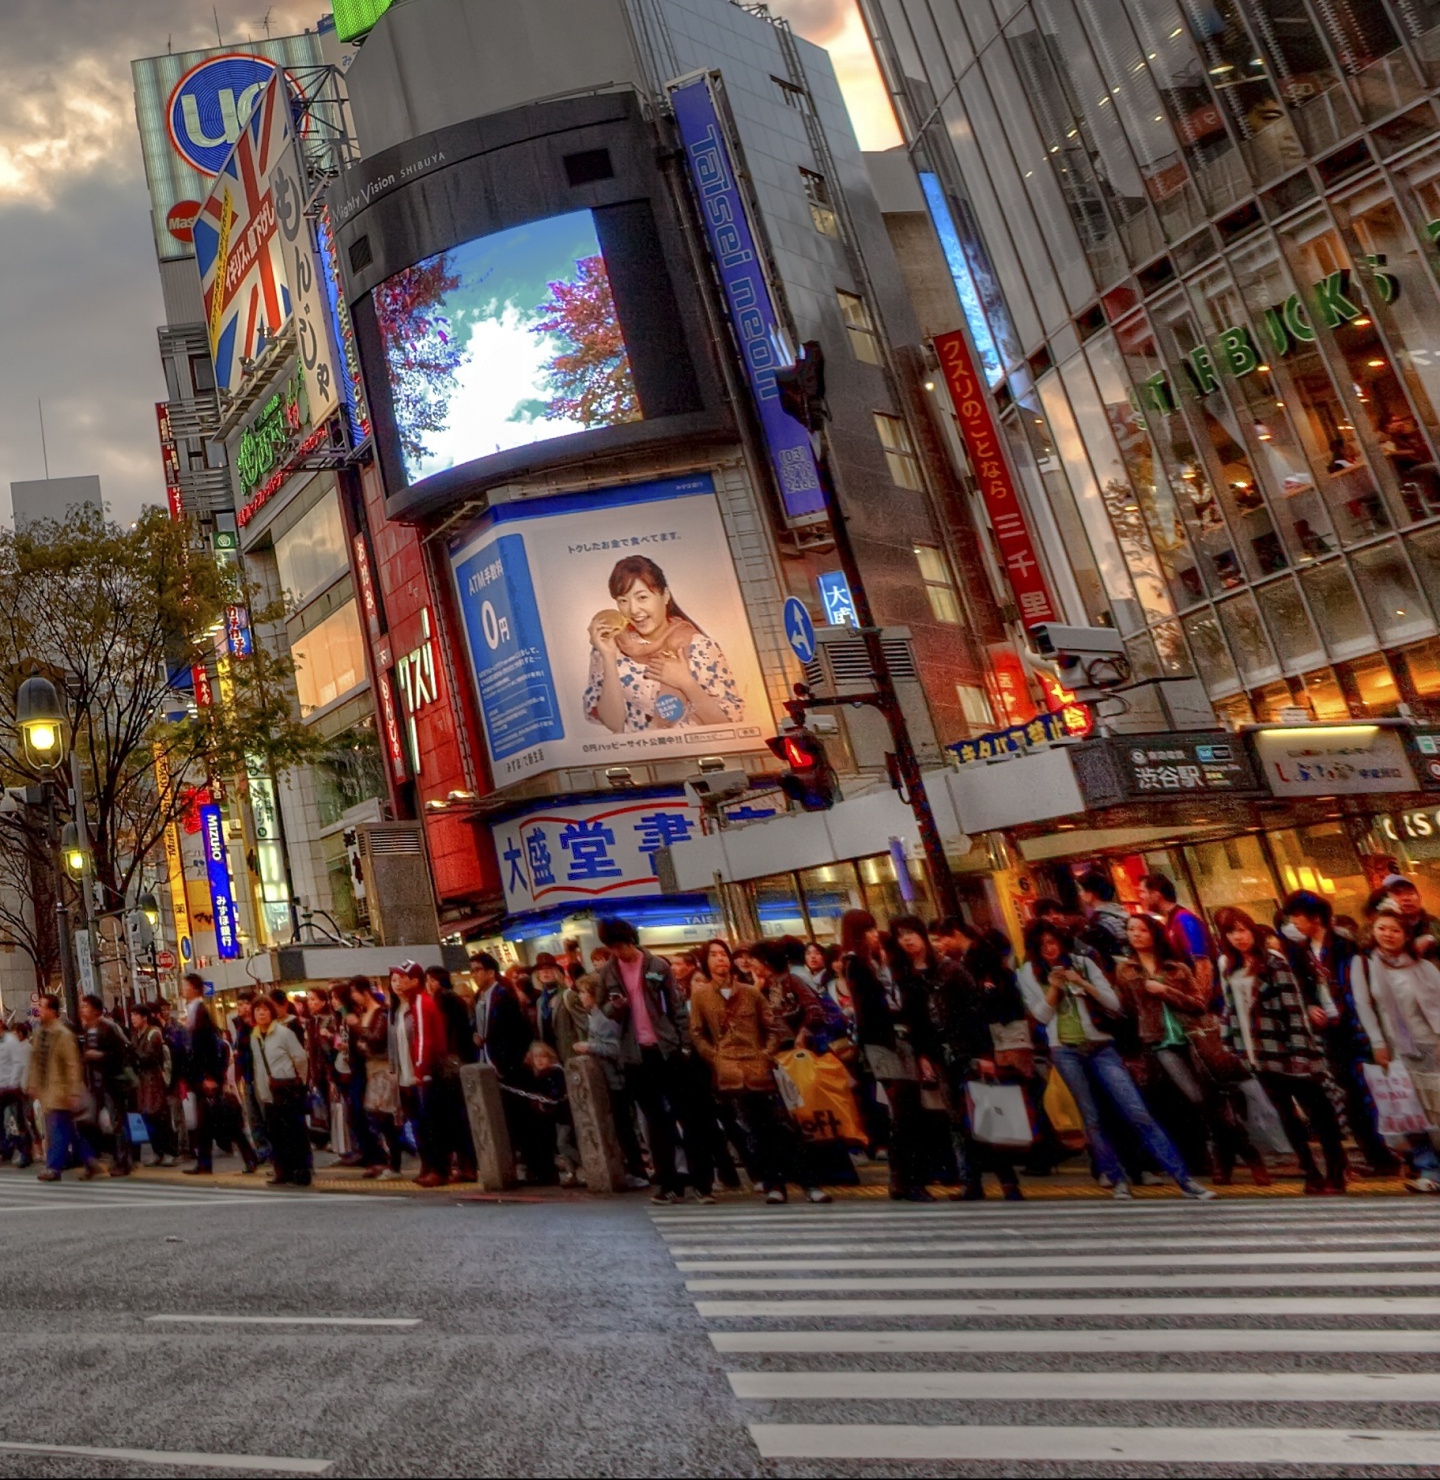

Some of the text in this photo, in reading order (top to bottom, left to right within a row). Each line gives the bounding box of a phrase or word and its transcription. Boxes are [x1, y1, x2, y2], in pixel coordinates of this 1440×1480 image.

[332, 151, 446, 224] Mighty Vision SHIBUYA
[688, 123, 780, 401] Taisei neon
[942, 340, 1053, 620] クスリのことなら 三千里
[480, 599, 511, 651] 0円
[1134, 766, 1205, 790] 渋谷駅
[206, 814, 222, 861] MIZUHO
[215, 895, 232, 947] みずほ銀行
